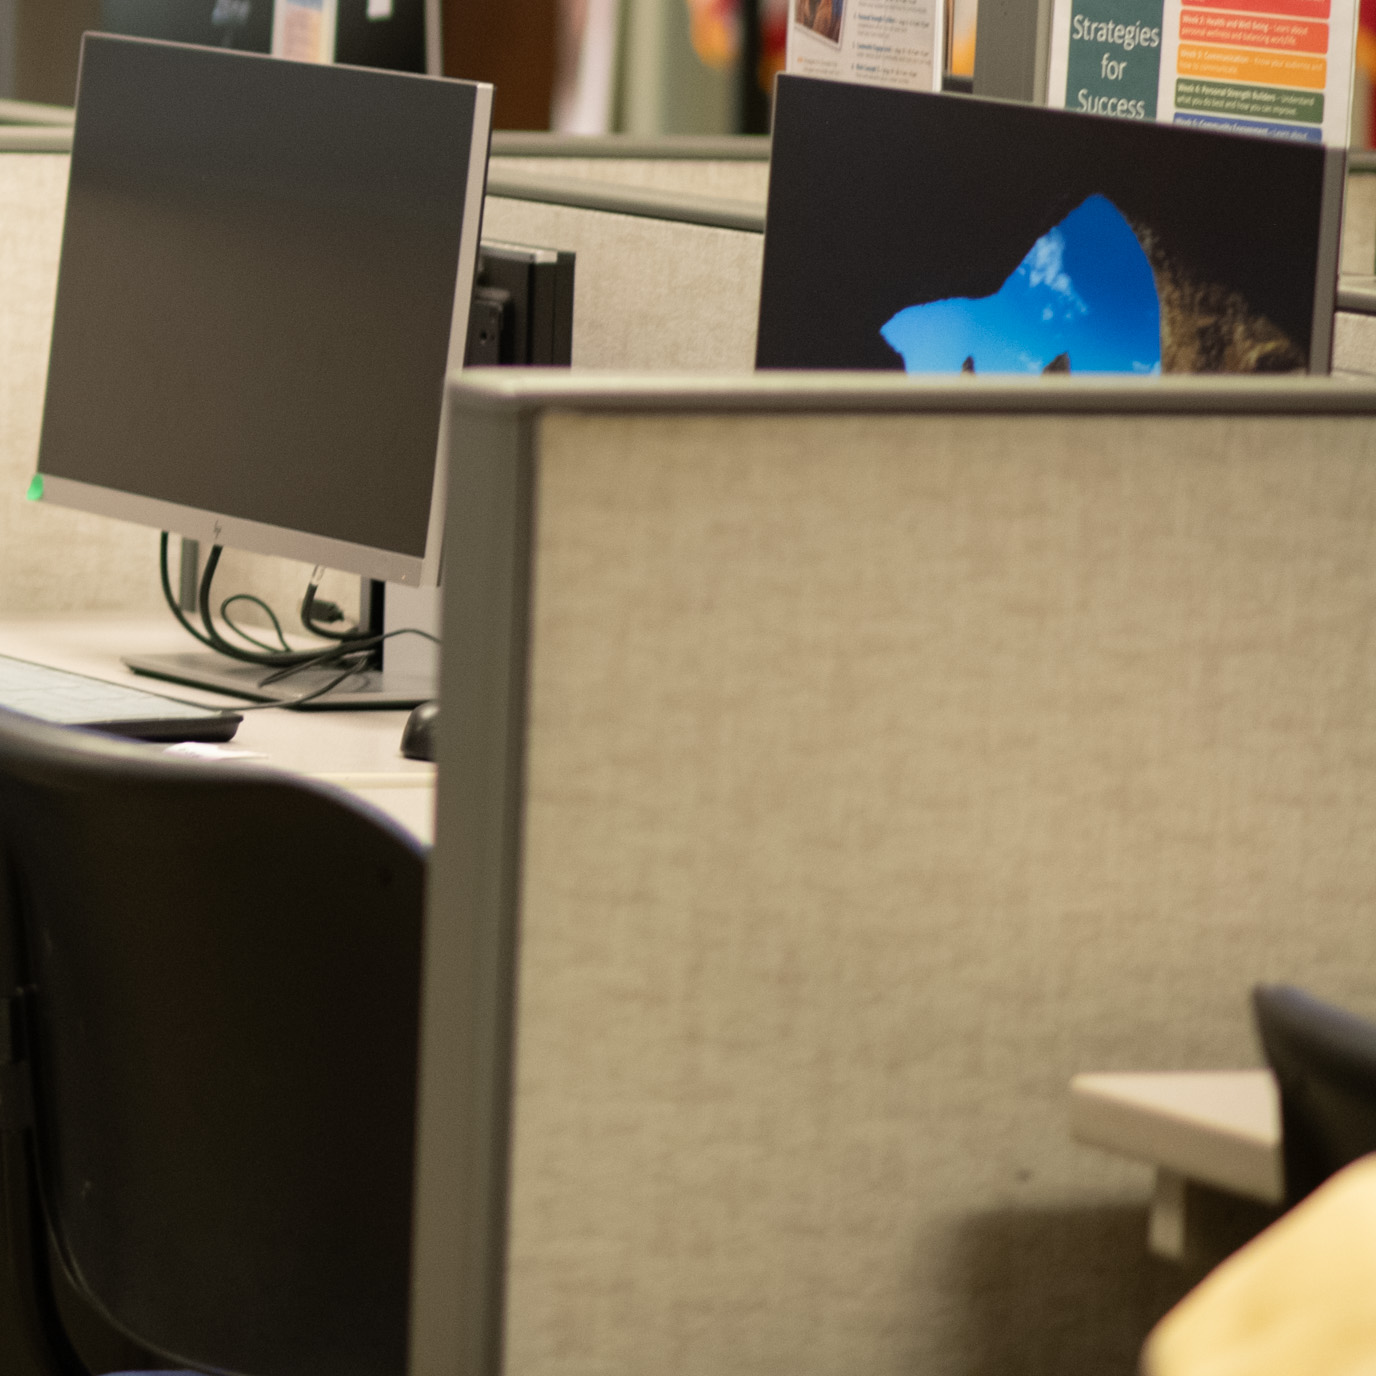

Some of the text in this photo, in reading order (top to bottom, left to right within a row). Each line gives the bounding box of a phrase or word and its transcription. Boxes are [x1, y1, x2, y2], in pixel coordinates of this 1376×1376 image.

[1072, 14, 1160, 51] Strategies
[1101, 52, 1128, 81] for
[1078, 88, 1146, 120] Success
